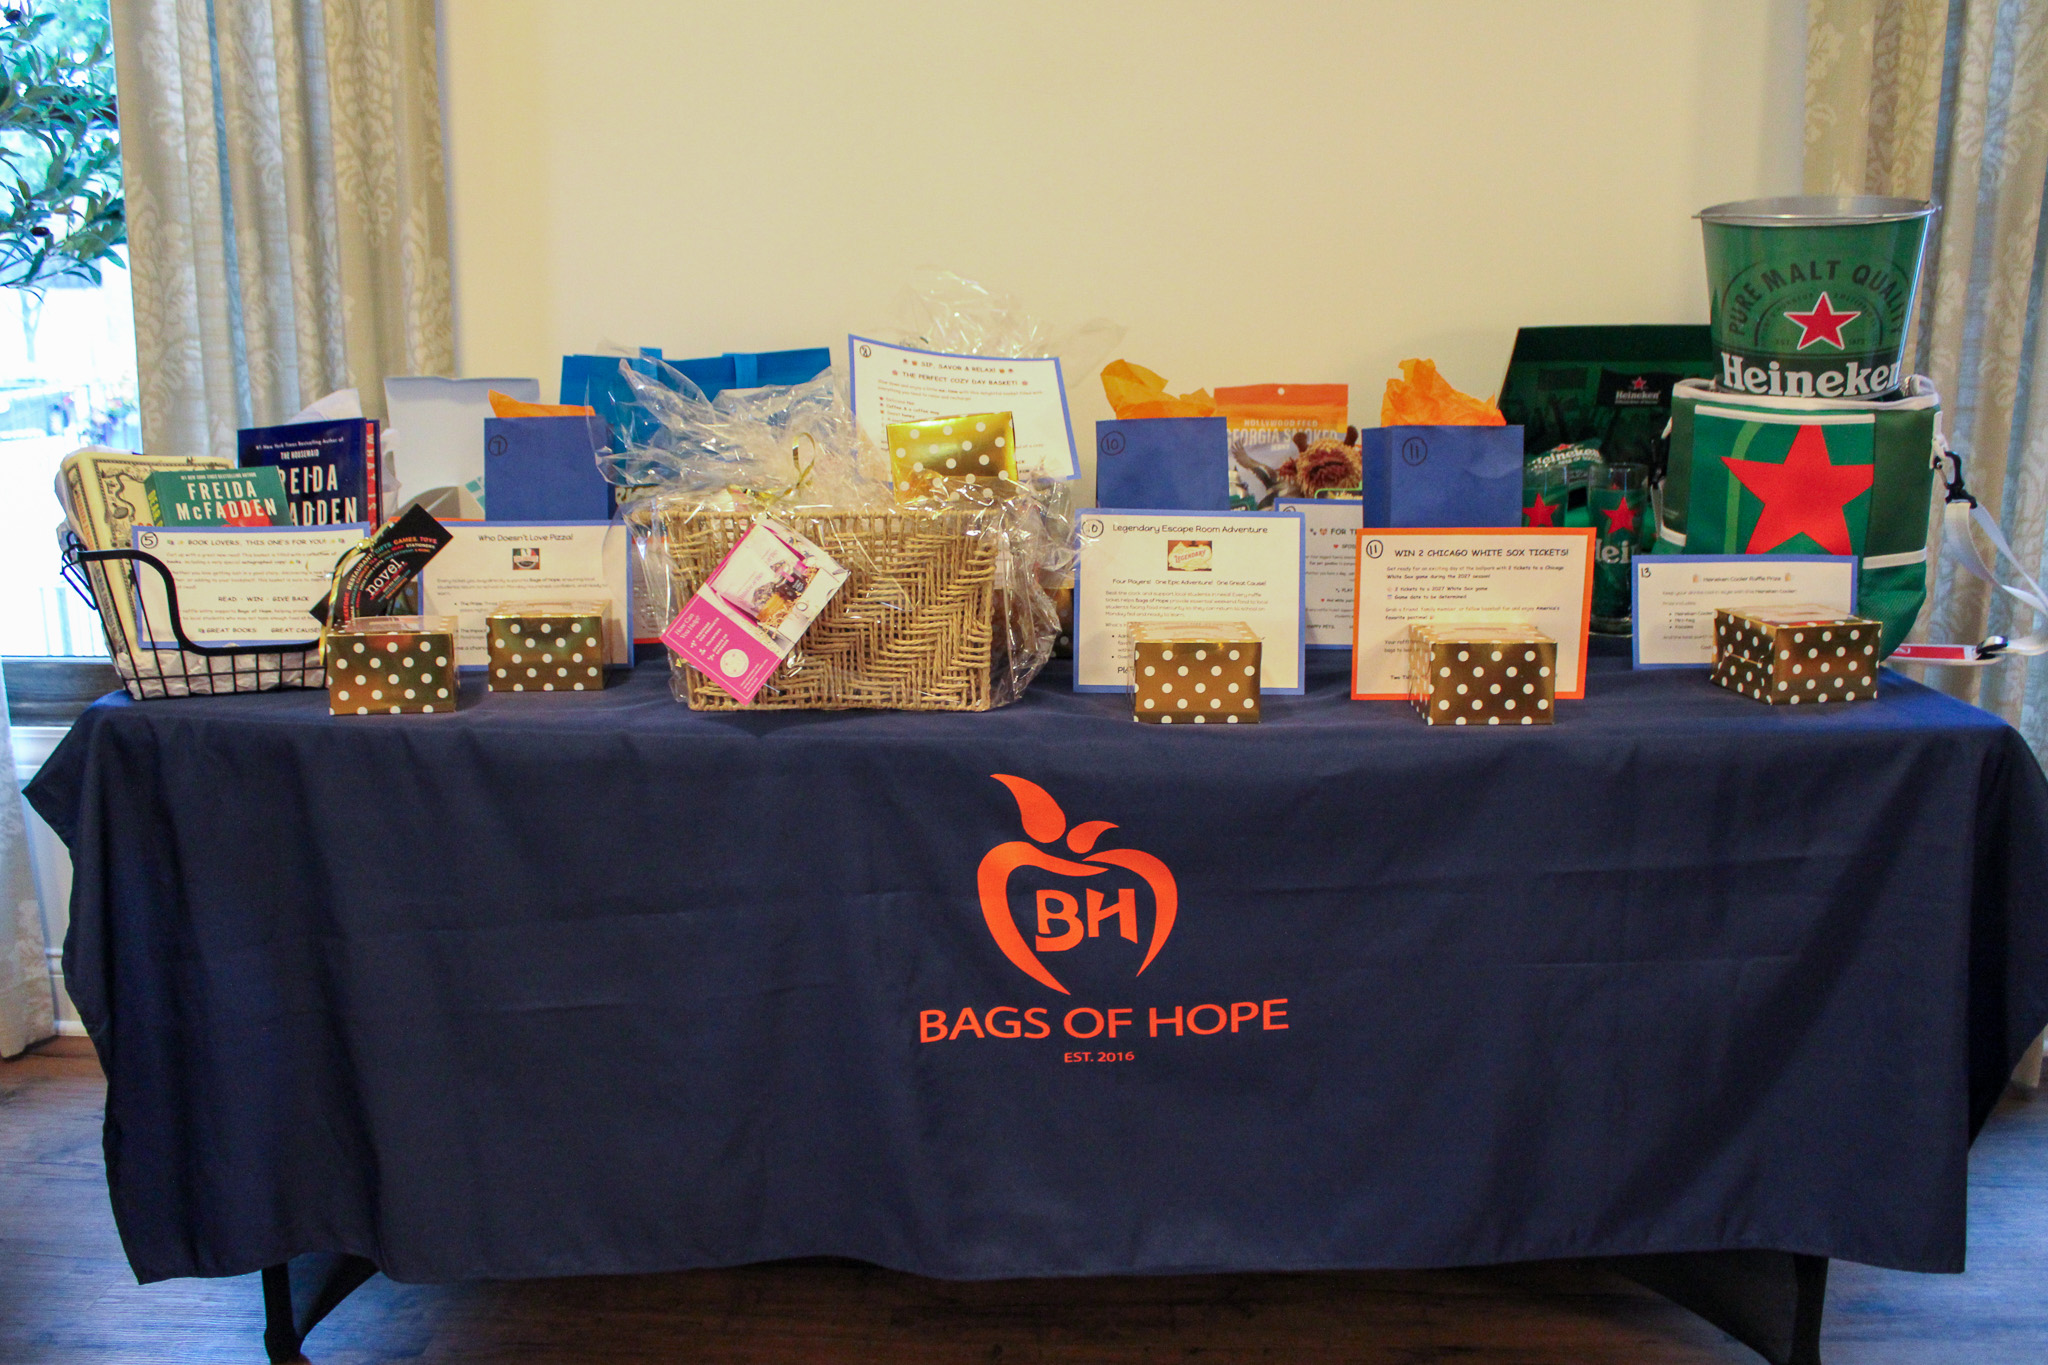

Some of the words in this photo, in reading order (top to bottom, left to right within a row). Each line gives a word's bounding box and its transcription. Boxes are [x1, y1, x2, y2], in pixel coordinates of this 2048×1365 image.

[1728, 282, 1762, 336] PURE
[1761, 260, 1841, 293] MALT
[1852, 264, 1905, 333] QUALITY
[902, 371, 916, 379] THE
[918, 373, 947, 383] PERFECT
[1616, 390, 1660, 400] Heineken
[1244, 419, 1295, 427] HOLLYWOOD
[1297, 419, 1318, 427] FEED
[280, 451, 290, 460] THE
[291, 448, 320, 459] HOUSEMAID
[278, 463, 338, 494] EIDA
[187, 480, 257, 501] FREIDA
[175, 498, 277, 521] McFADDEN
[289, 496, 357, 526] ADDEN
[1112, 524, 1160, 534] Legendary
[1162, 524, 1194, 534] Escape
[1196, 525, 1221, 533] Room
[1221, 526, 1268, 534] Adventure
[1174, 549, 1207, 564] LEGENDARY
[1394, 549, 1415, 557] WIN
[1418, 549, 1424, 557] 2
[1427, 549, 1468, 557] CHICAGO
[1471, 549, 1503, 557] WHITE
[1529, 548, 1569, 556] TICKETS!
[365, 558, 405, 596] novel.
[1641, 567, 1651, 578] 13
[1035, 887, 1138, 952] BH
[919, 1006, 1052, 1043] BAGS
[1063, 1007, 1133, 1039] OF
[1149, 998, 1290, 1038] HOPE
[1063, 1051, 1095, 1063] EST.
[1097, 1050, 1135, 1063] 2016
